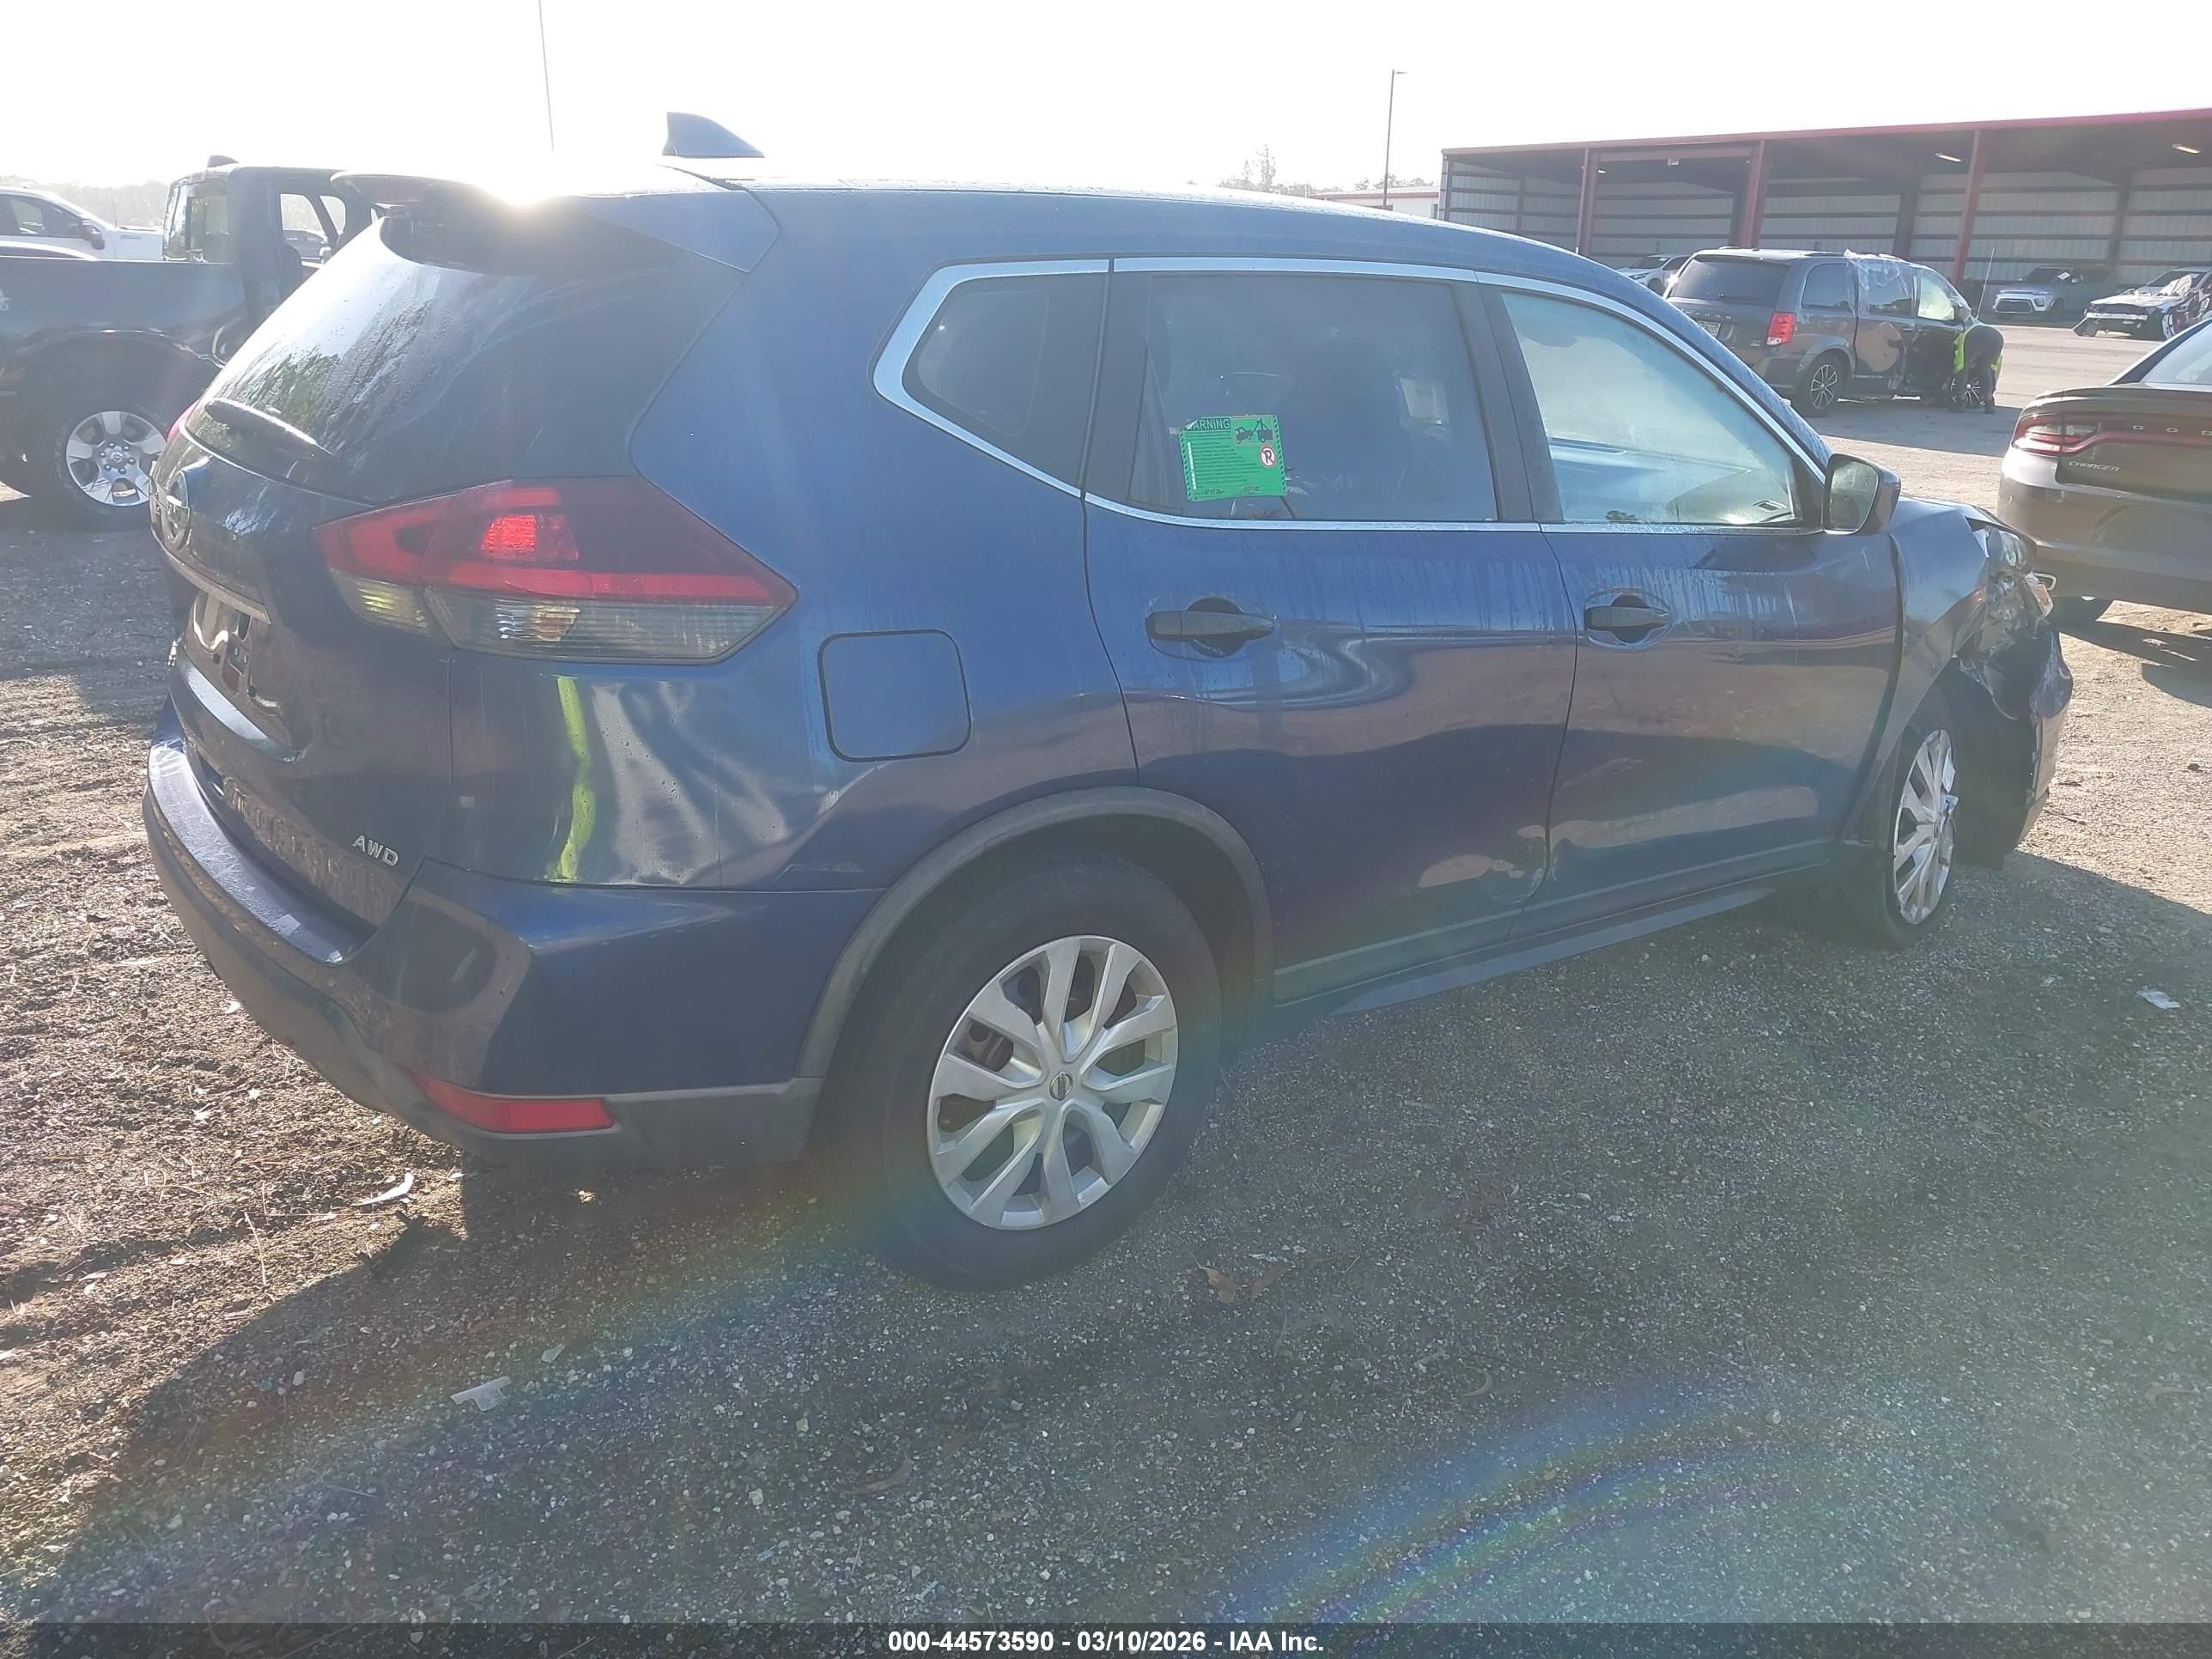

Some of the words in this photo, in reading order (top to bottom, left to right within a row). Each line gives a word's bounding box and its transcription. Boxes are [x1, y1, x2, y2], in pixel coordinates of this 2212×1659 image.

[1191, 418, 1231, 430] ARNING
[2069, 461, 2120, 471] CHARGER
[352, 835, 398, 866] AWD
